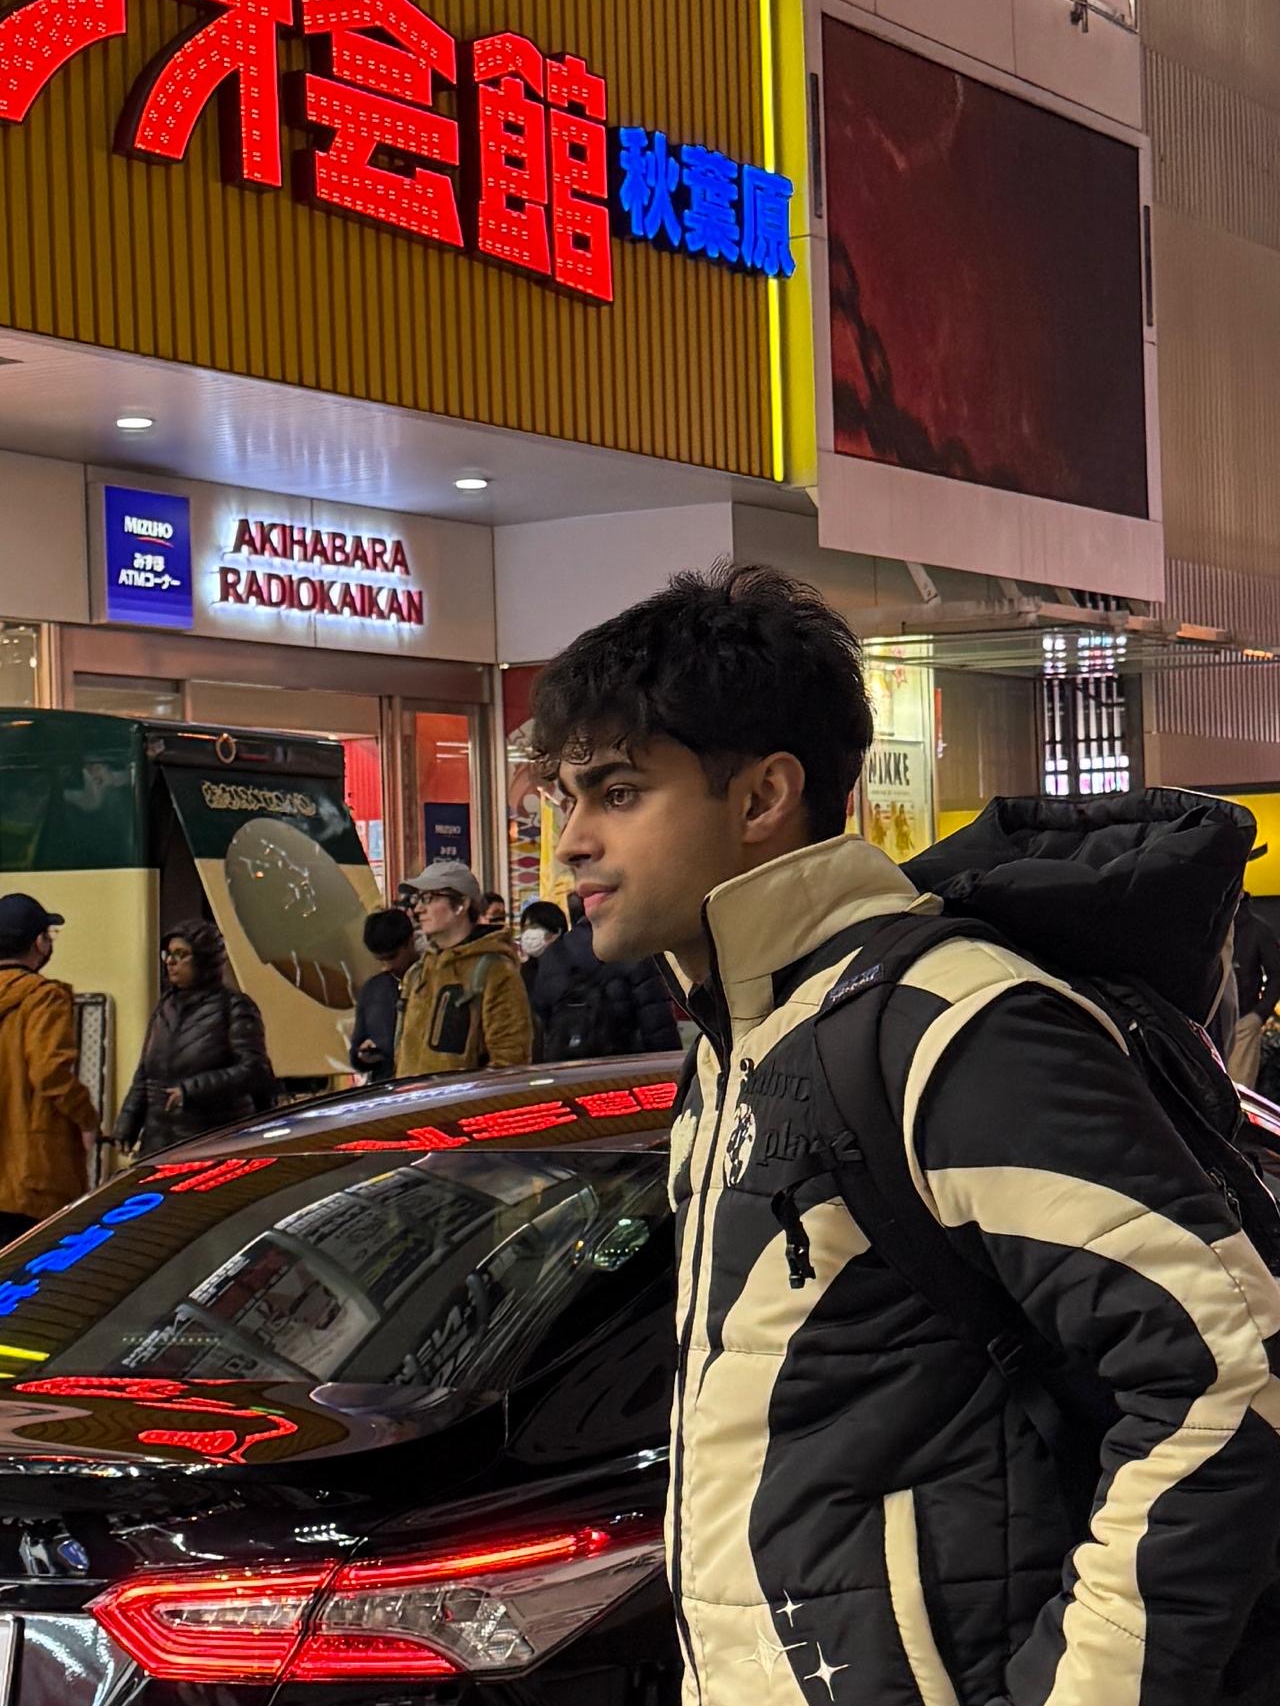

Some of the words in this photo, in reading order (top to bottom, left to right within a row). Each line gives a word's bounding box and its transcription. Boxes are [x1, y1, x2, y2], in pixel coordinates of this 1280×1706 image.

[613, 123, 797, 281] 秋葉原
[123, 514, 174, 540] MIZUHO
[231, 517, 412, 577] AKIHABARA
[218, 566, 424, 626] RADIOKAIKAN
